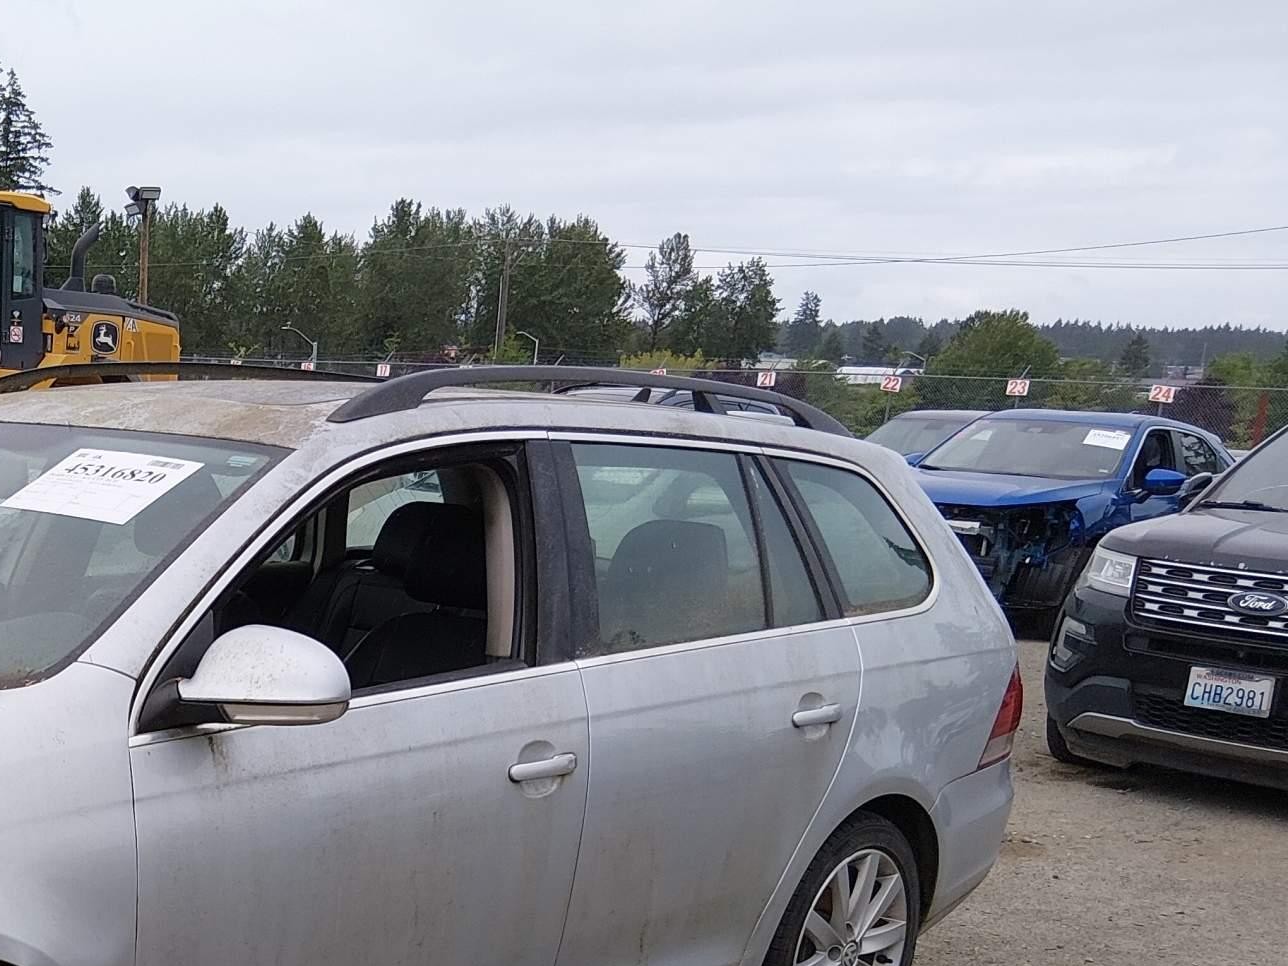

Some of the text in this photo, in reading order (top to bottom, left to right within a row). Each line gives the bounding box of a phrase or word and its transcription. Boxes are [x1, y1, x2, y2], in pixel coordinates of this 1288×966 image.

[760, 373, 773, 386] 21
[883, 376, 900, 390] 22
[1008, 380, 1027, 394] 23
[1152, 386, 1172, 401] 24
[64, 462, 168, 485] 45316820
[1239, 594, 1276, 610] Ford
[1190, 681, 1265, 710] CHB2981
